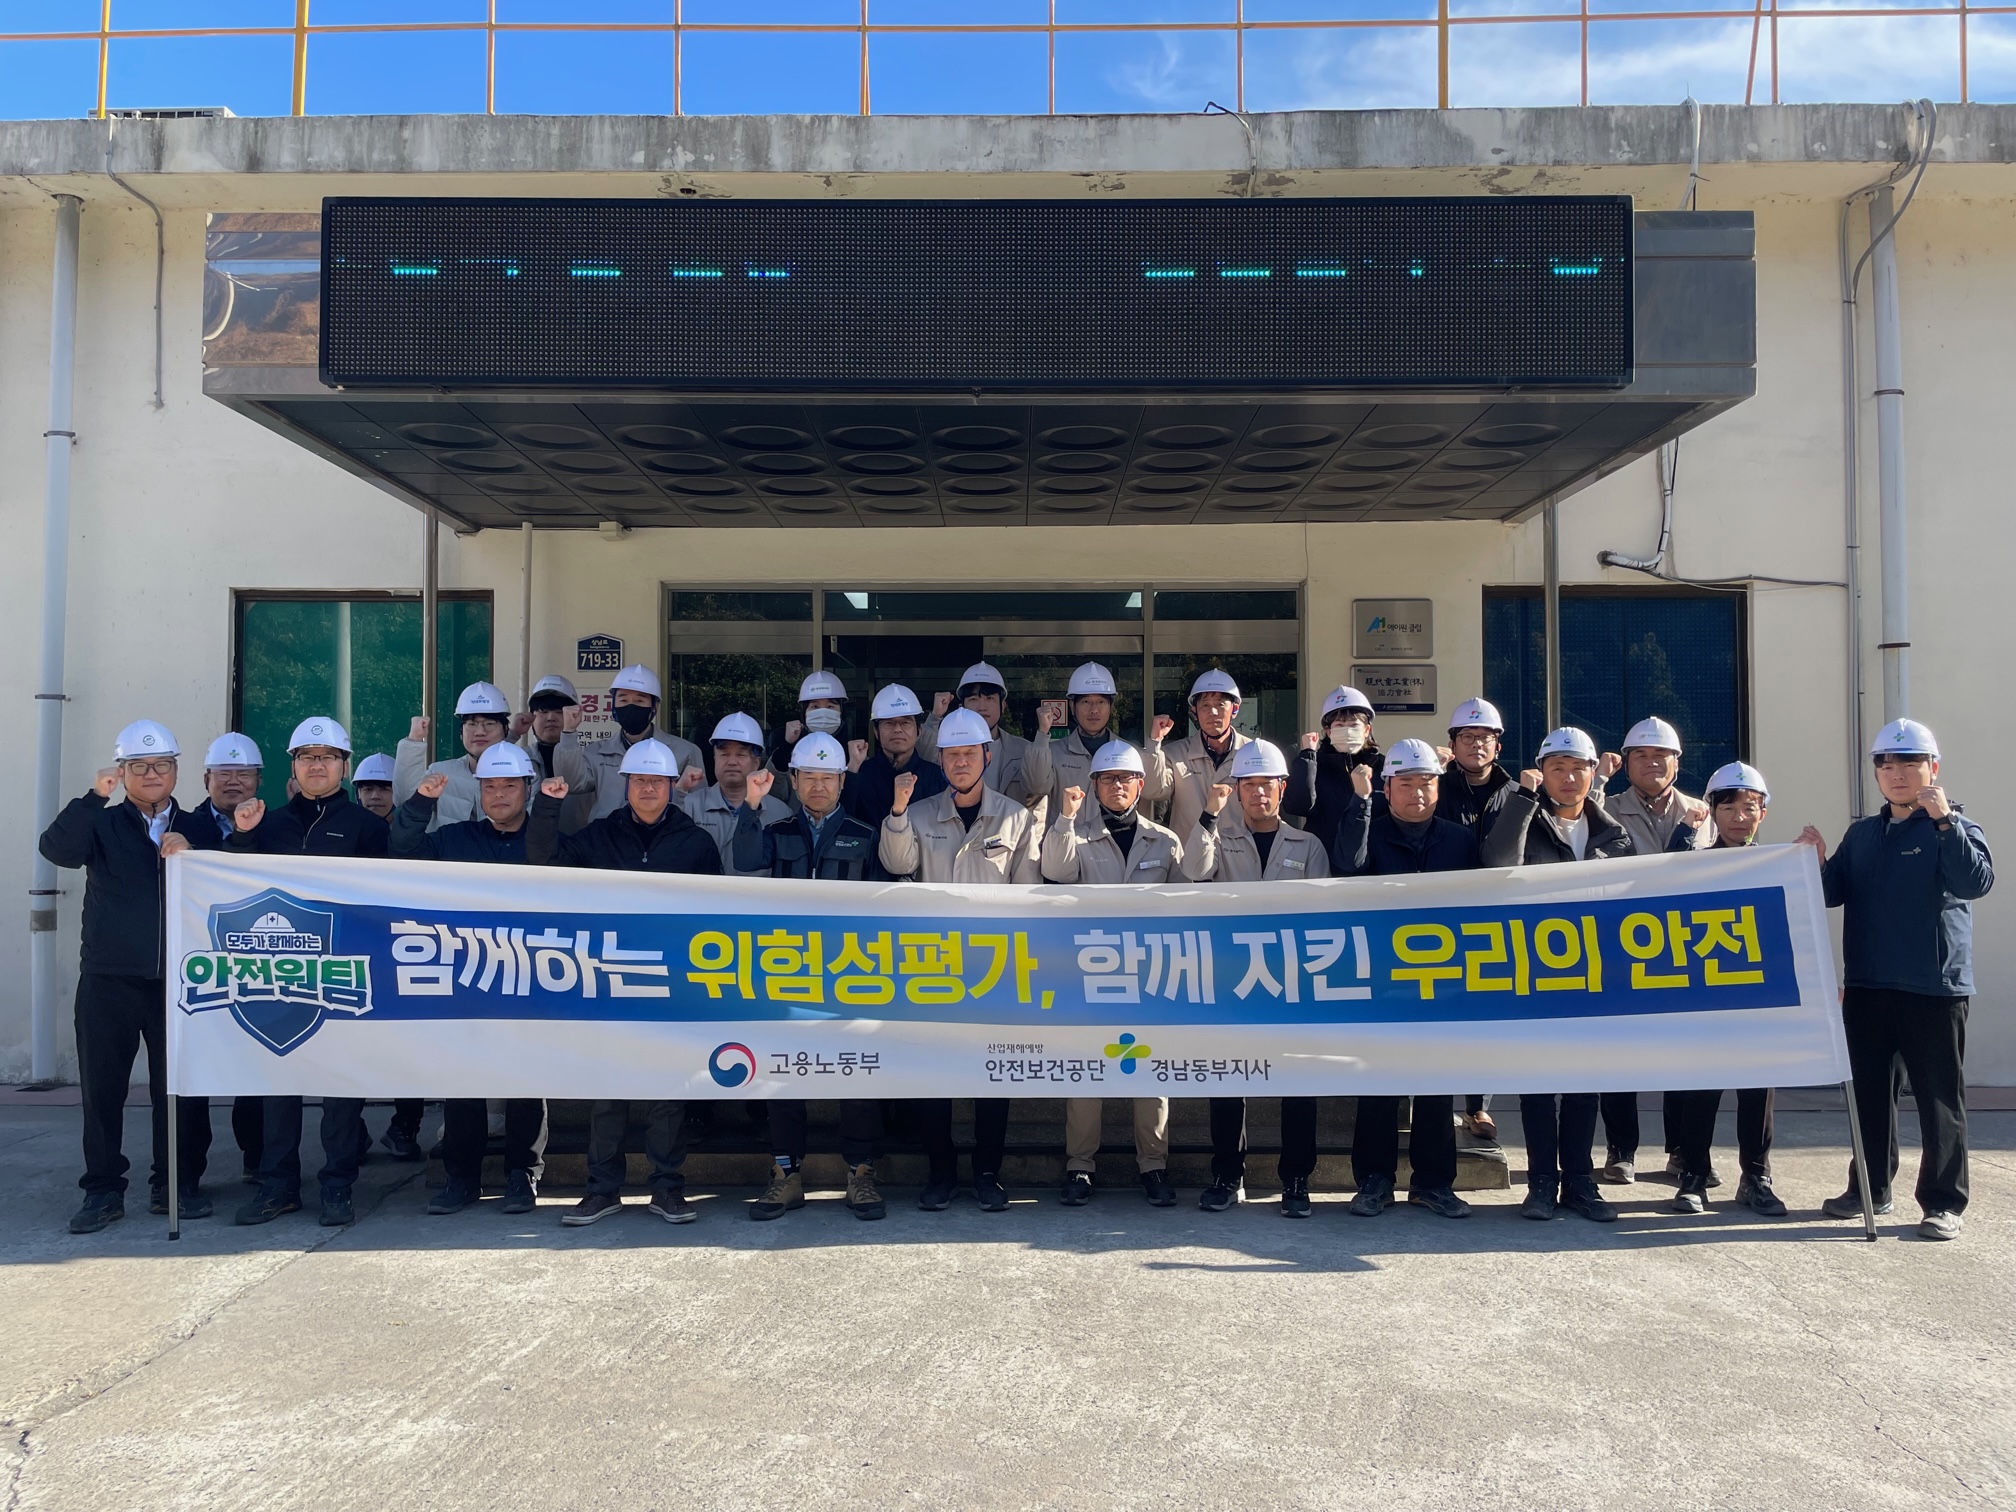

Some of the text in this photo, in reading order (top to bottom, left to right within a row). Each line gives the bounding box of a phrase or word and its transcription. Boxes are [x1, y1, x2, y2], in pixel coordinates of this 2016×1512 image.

[1387, 623, 1422, 633] 에이원 클럽
[580, 653, 619, 667] 719-33
[1377, 688, 1412, 697] 協力會社
[226, 933, 321, 951] 모두가 함께하는
[391, 905, 1765, 1009] 함께하는 위험성평가, 함께 지킨 우리의 안전
[184, 953, 370, 1012] 안전원팀
[986, 1043, 1044, 1054] 산업재해예방
[769, 1051, 881, 1077] 고용노동부
[985, 1059, 1272, 1083] 안전보건공단 경남동부지사
